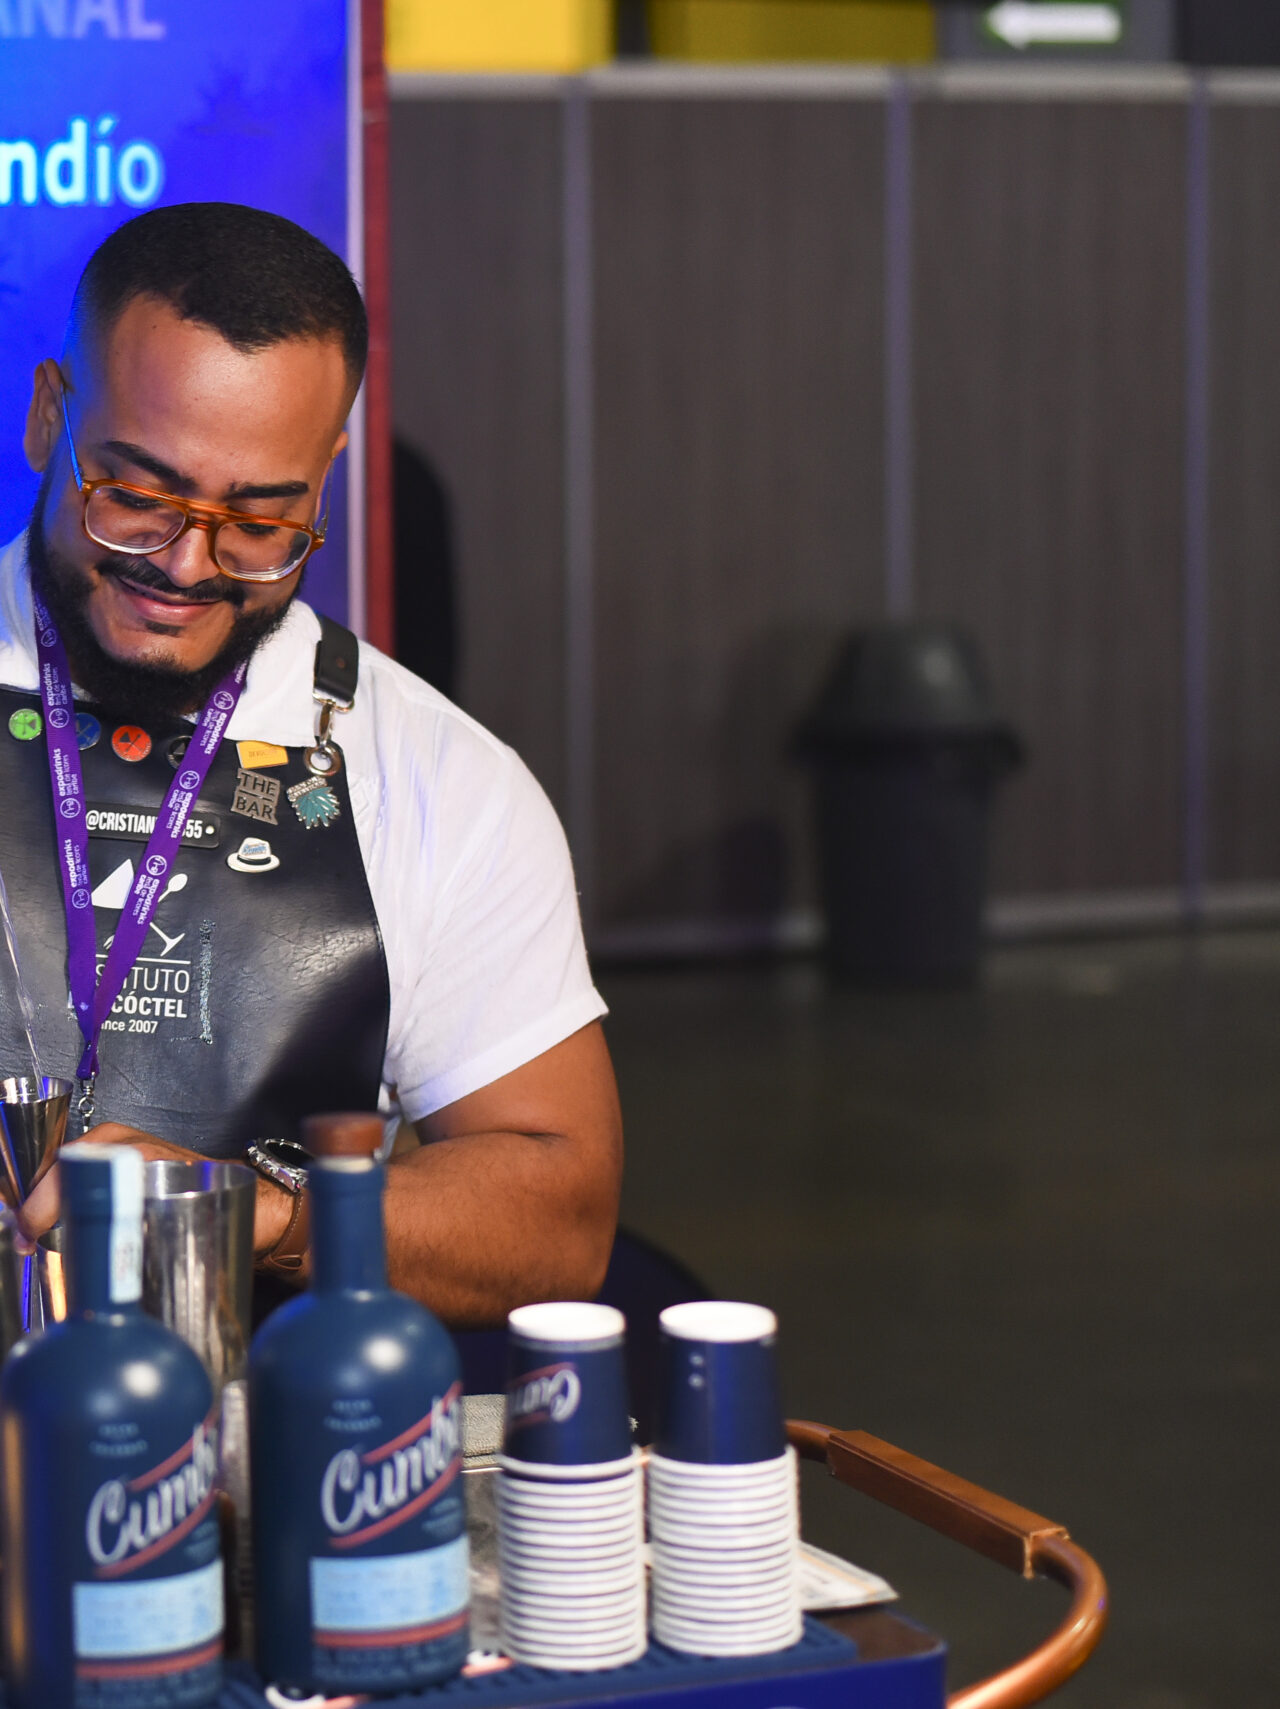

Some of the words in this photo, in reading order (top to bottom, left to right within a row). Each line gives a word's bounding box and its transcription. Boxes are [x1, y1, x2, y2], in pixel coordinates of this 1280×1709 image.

[43, 663, 56, 706] expodrinks
[204, 712, 227, 755] expodrinks
[53, 748, 66, 797] expodrinks
[241, 772, 278, 797] THE
[170, 792, 193, 839] expodrinks
[236, 796, 273, 820] BAR
[64, 839, 78, 888] expodrinks
[137, 878, 160, 925] expodrinks
[111, 991, 188, 1018] CÓCTEL
[128, 1019, 158, 1034] 2007
[320, 1395, 462, 1534] Cumb
[85, 1423, 218, 1565] Cumb
